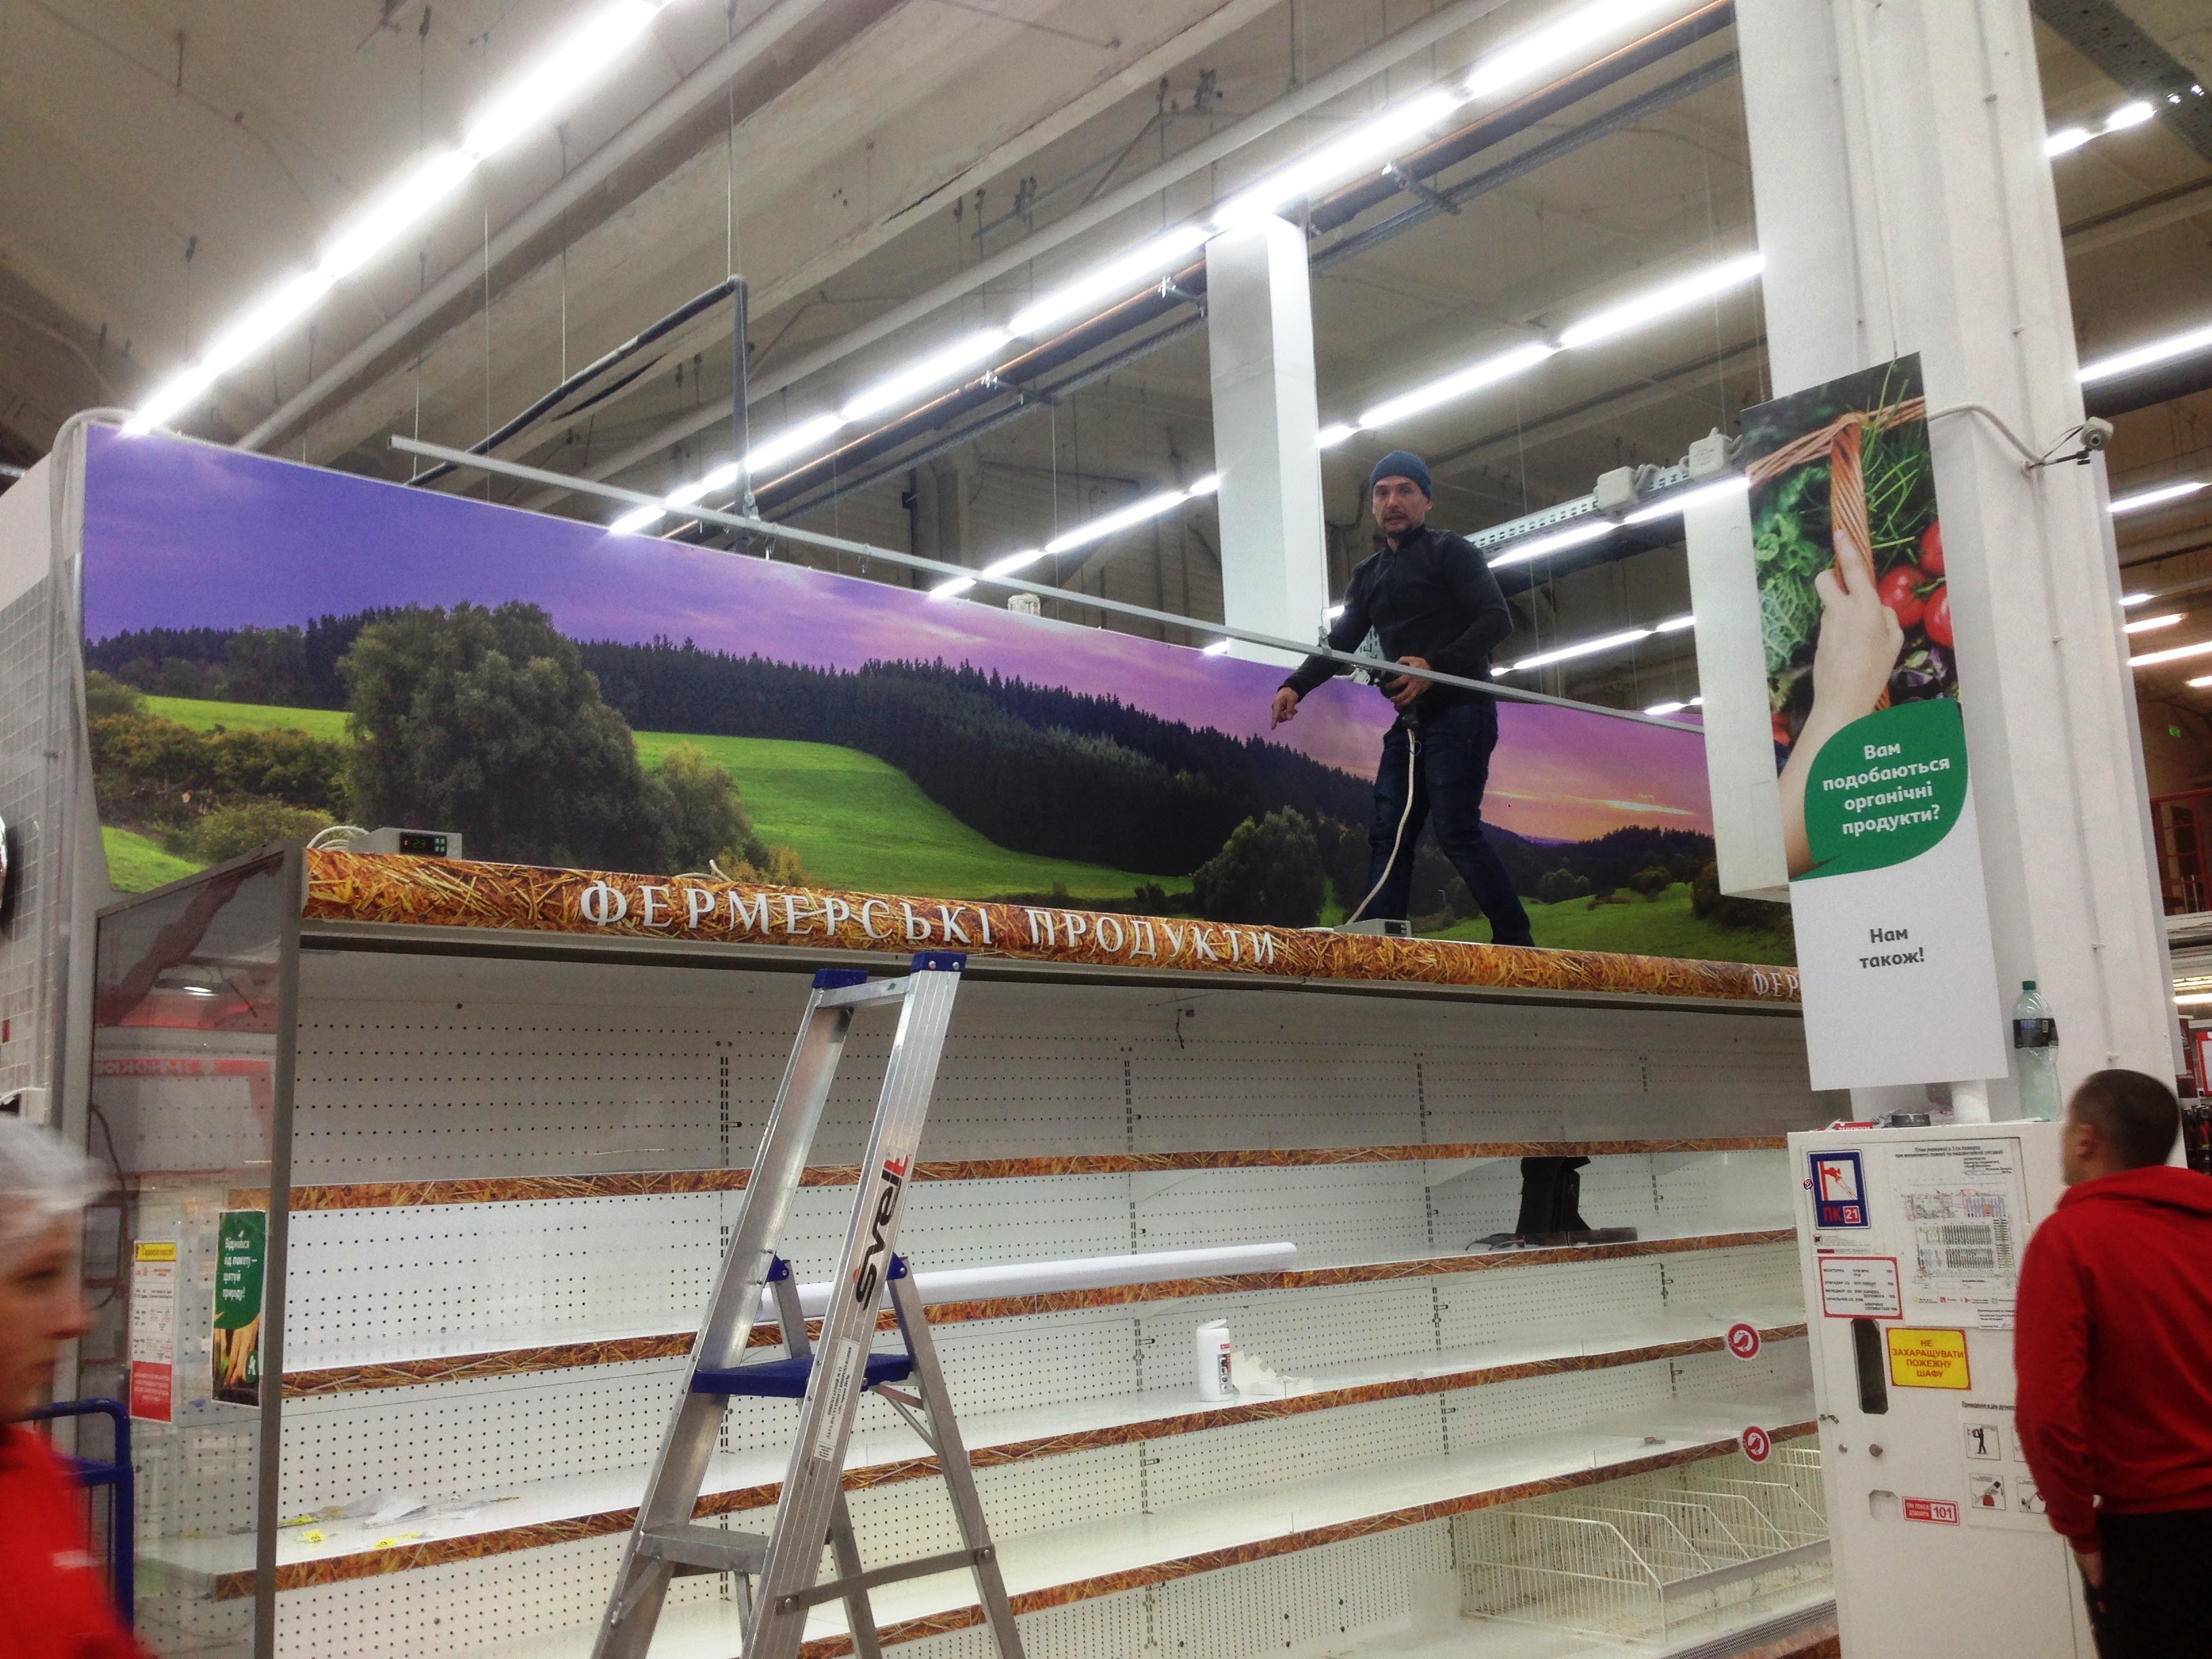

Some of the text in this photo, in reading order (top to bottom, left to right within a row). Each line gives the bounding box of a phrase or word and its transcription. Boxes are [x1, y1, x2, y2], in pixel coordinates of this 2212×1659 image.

[1864, 743, 1901, 760] Вам
[1823, 758, 1950, 790] подобаються
[1844, 781, 1933, 813] органічні
[1843, 804, 1940, 836] продукти?
[580, 881, 1275, 964] ФЕРМЕРСЬКІ ПРОДУКТИ
[1870, 928, 1908, 943] Нам
[1860, 947, 1925, 968] також!
[1823, 1207, 1858, 1221] ПК 21
[1892, 1349, 1964, 1358] ЗАХАРАЩУВАТИ
[1906, 1359, 1951, 1368] ПОЖЕЖНУ
[1917, 1370, 1944, 1378] ШАФУ
[1933, 1507, 1952, 1519] 101
